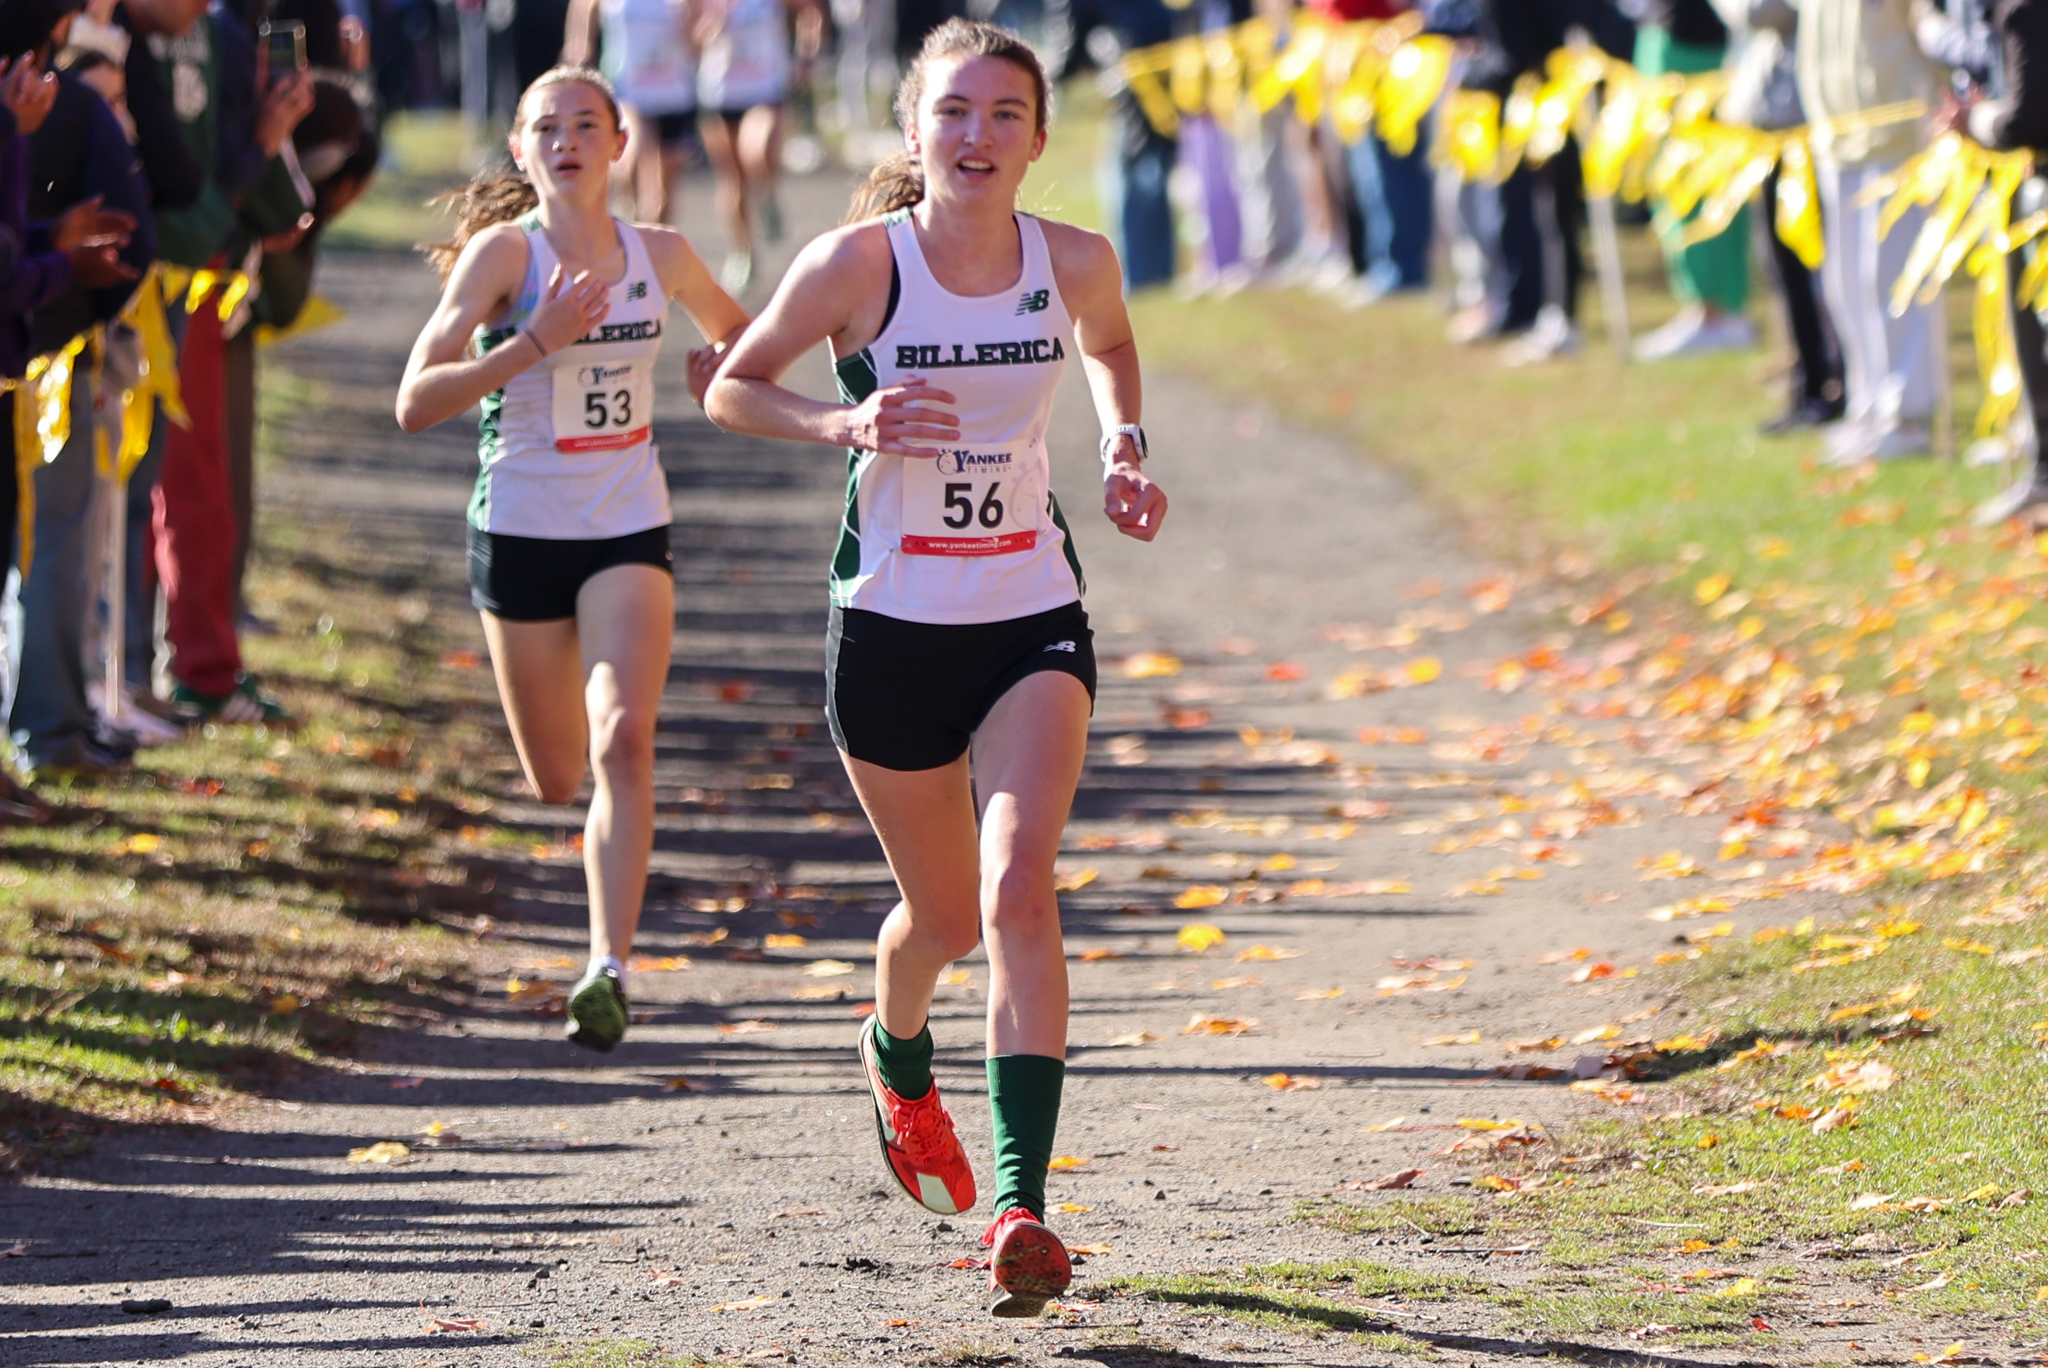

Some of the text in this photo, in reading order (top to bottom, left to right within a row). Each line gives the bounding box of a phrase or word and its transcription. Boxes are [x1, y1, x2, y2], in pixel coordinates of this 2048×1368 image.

[1015, 289, 1050, 316] NB
[895, 337, 1065, 369] BILLERICA
[584, 389, 631, 429] 53
[953, 450, 1012, 473] YANKEE
[968, 466, 1008, 474] TIMING
[943, 481, 1004, 529] 56
[928, 539, 1012, 550] www.yankeetiming.com
